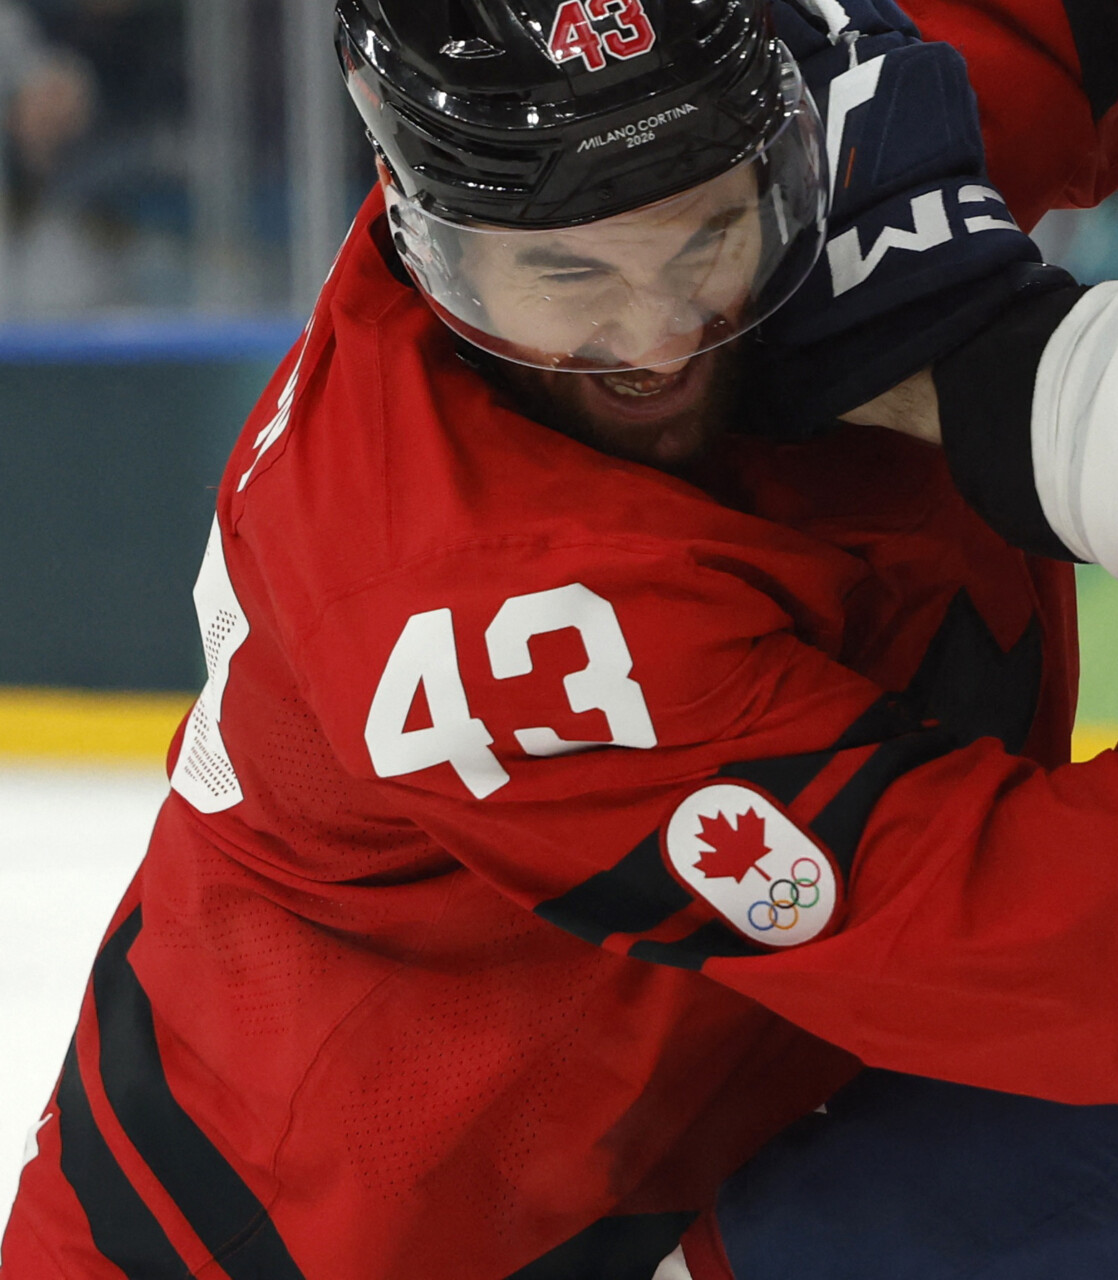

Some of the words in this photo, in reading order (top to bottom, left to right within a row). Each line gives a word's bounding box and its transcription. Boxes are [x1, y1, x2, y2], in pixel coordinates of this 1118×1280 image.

[577, 124, 637, 154] MILANO
[637, 103, 699, 132] CORTINA
[626, 130, 656, 148] 2026
[364, 582, 658, 800] 43
